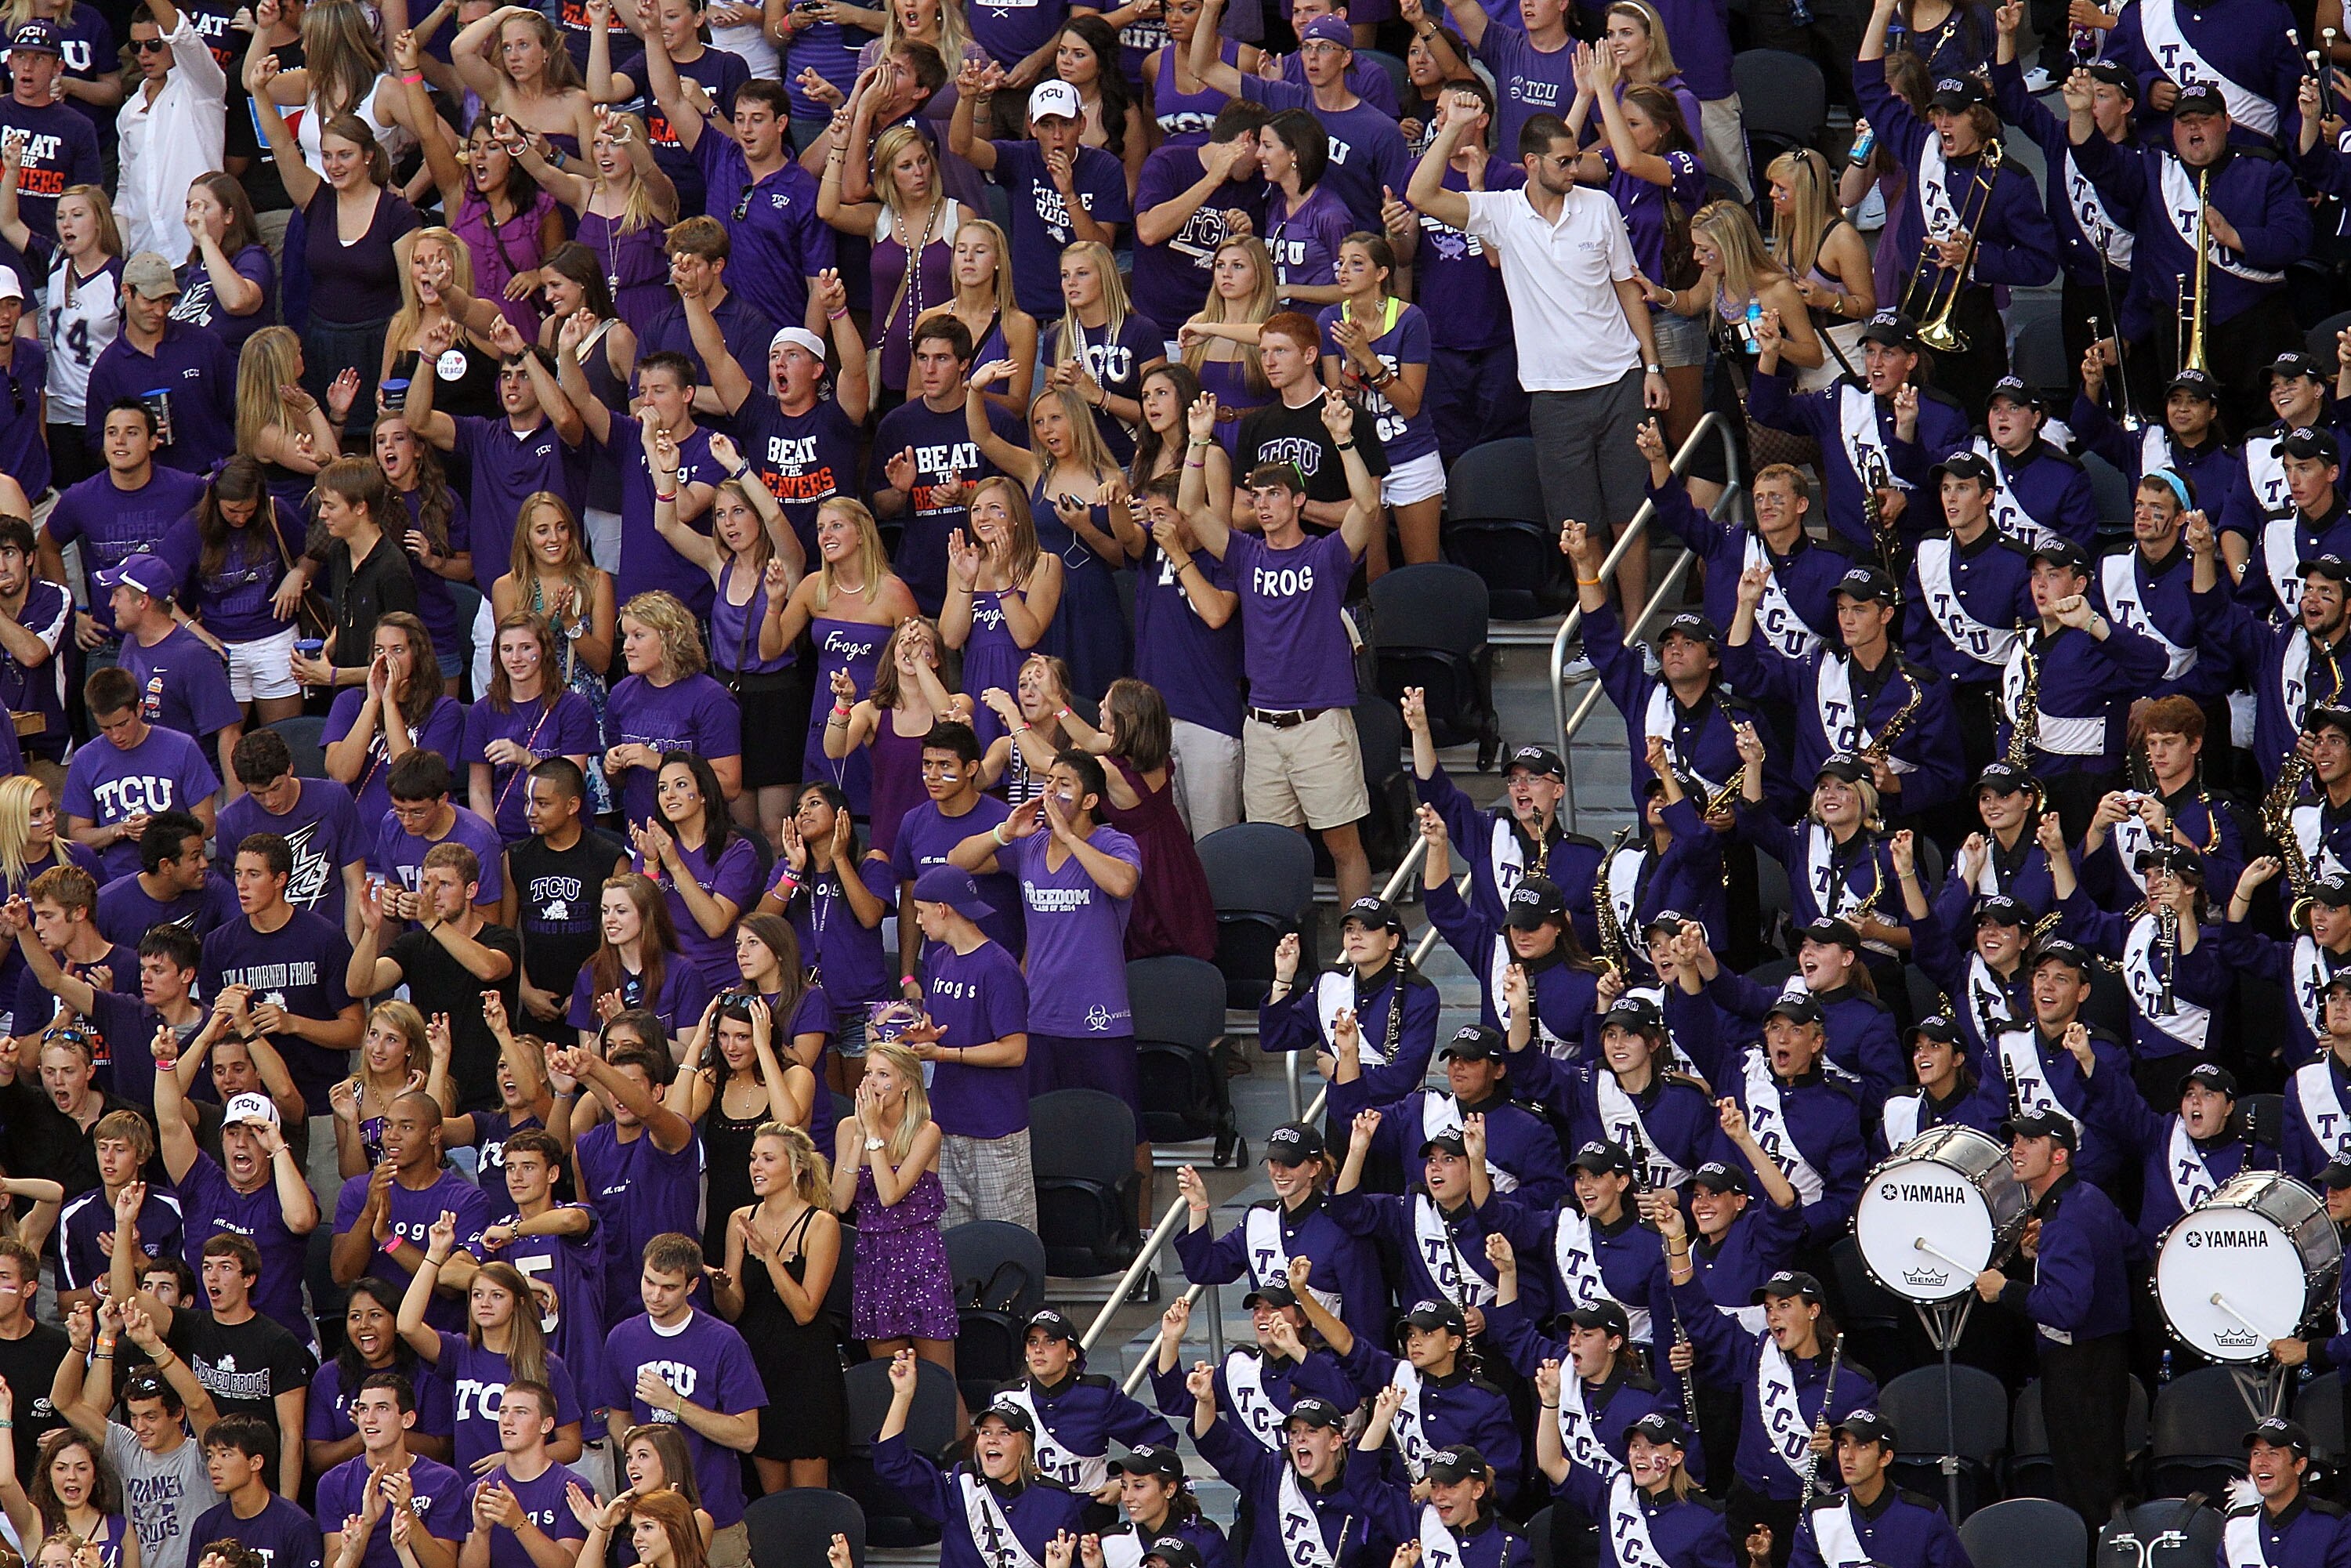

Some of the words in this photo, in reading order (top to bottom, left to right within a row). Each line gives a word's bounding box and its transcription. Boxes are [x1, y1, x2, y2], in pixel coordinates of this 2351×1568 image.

[1040, 89, 1063, 102] TCU
[1527, 82, 1558, 100] TCU
[20, 156, 37, 168] HE
[772, 194, 790, 204] TCU
[1033, 179, 1089, 210] PURPE
[1035, 202, 1071, 226] RAG
[2179, 209, 2235, 266] TU
[183, 368, 200, 378] TCU
[1083, 345, 1131, 384] CU
[766, 436, 817, 463] BEAT
[917, 447, 980, 473] BEAT
[1259, 438, 1320, 476] TCU
[762, 468, 835, 499] EAVERS
[779, 465, 803, 476] THE
[1254, 566, 1315, 598] FROG
[1934, 594, 1990, 655] TCU
[2117, 601, 2144, 638] TC
[824, 630, 871, 661] Frogs
[1823, 701, 1855, 752] TC
[93, 776, 173, 819] TCU
[531, 877, 581, 903] TCU
[246, 963, 288, 989] HORNED
[289, 961, 317, 987] FROG
[1610, 998, 1640, 1012] TCU
[234, 1099, 260, 1111] TCU
[1271, 1128, 1299, 1143] TCU
[1614, 1124, 1672, 1186] TU
[1901, 1184, 1965, 1206] YAMAHA
[2179, 1159, 2207, 1208] TC
[2205, 1229, 2269, 1249] YAMAHA
[1567, 1248, 1598, 1301] TC
[1909, 1275, 1943, 1285] REMO
[2220, 1337, 2252, 1346] REMO
[230, 1367, 270, 1396] FROGS
[455, 1379, 505, 1422] TC
[1766, 1379, 1809, 1460] TCU
[1037, 1447, 1082, 1489] CU
[1284, 1513, 1319, 1566] TC
[1615, 1511, 1652, 1568] TC
